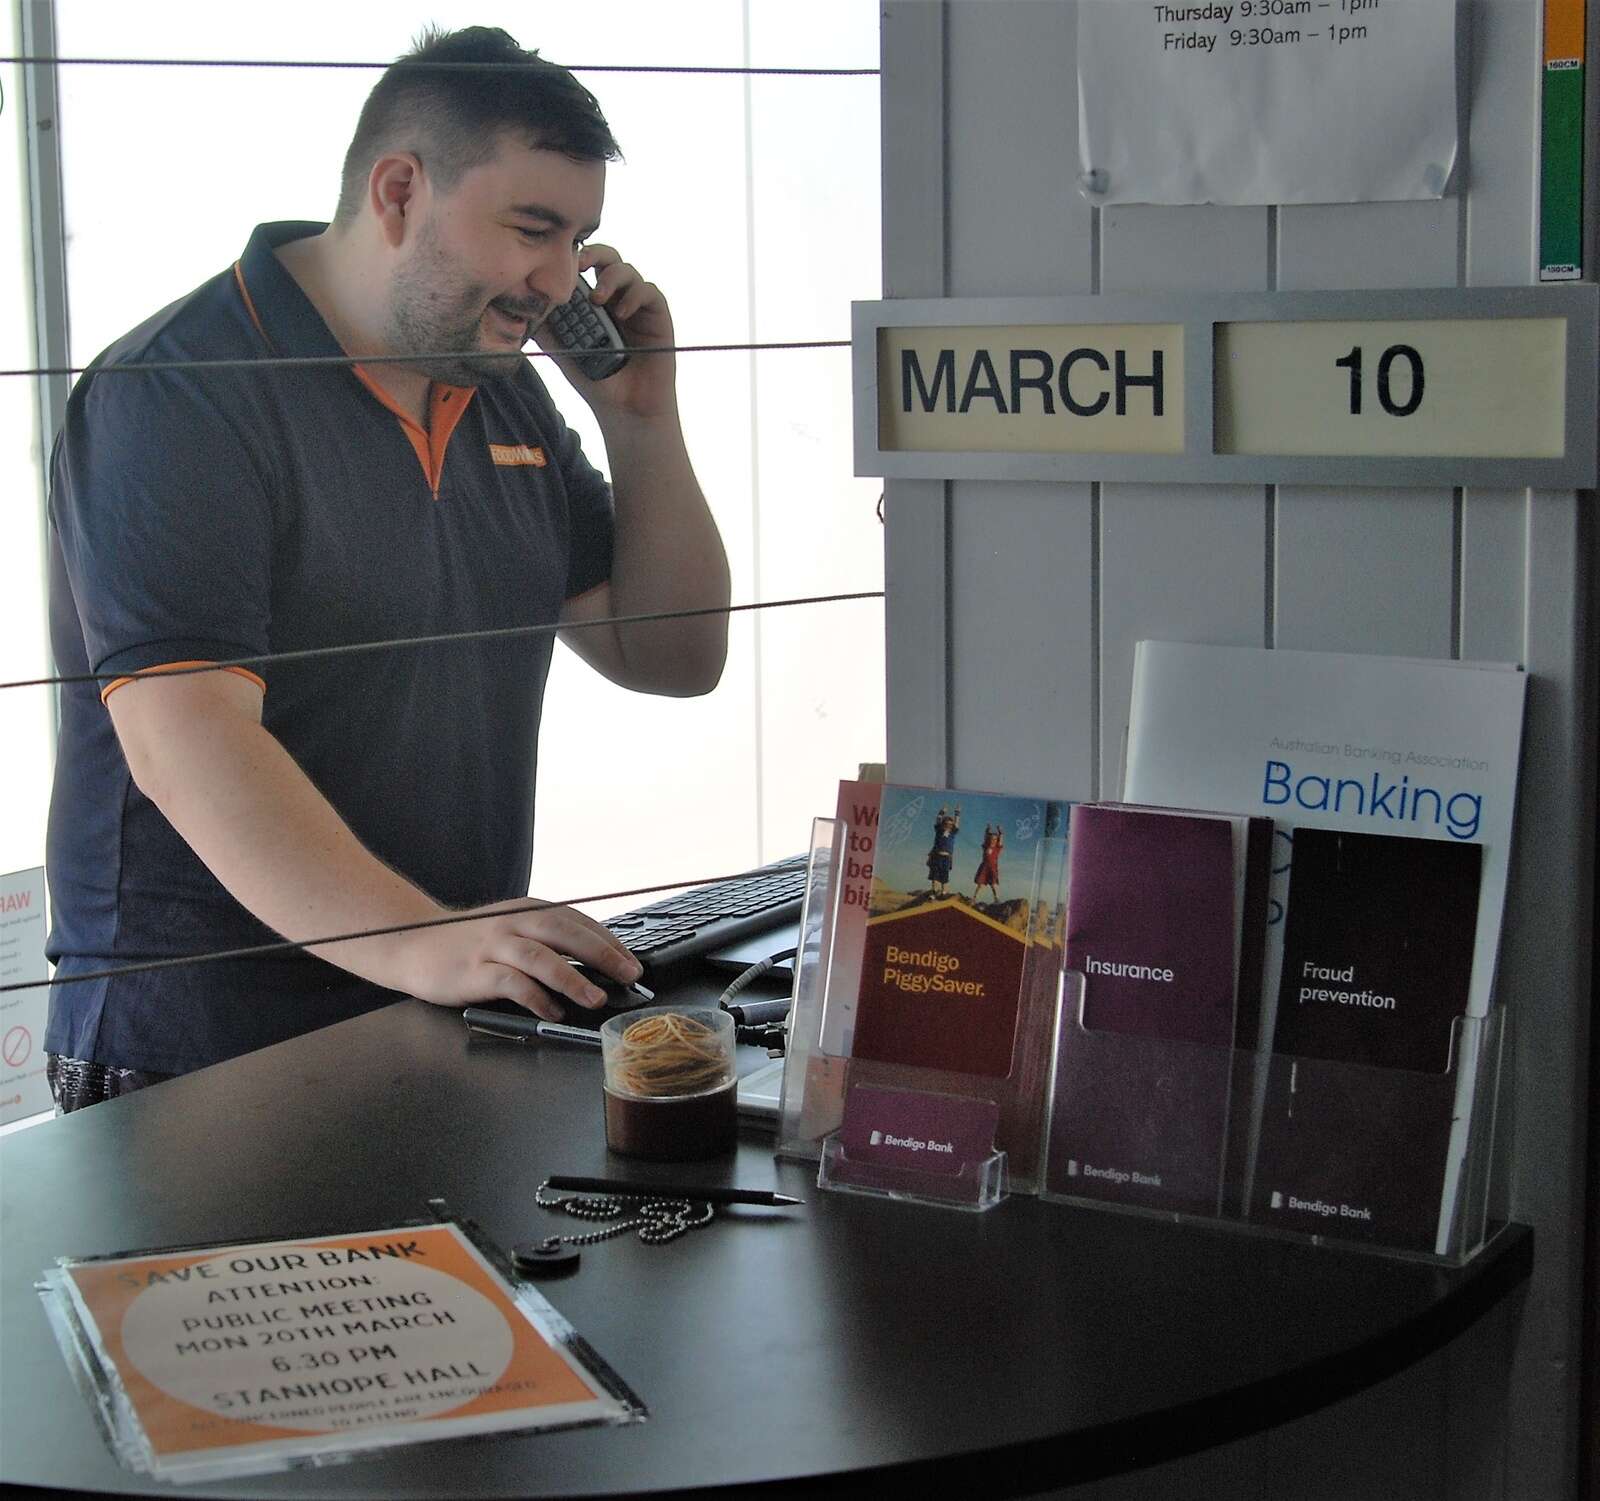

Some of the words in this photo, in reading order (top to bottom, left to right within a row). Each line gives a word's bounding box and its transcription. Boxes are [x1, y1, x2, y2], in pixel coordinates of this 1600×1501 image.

[1153, 5, 1234, 24] Thursday
[1240, 0, 1311, 18] 9:30am
[1163, 31, 1217, 53] Friday
[1229, 27, 1301, 46] 9:30am
[1327, 24, 1368, 45] 1pm
[900, 347, 1165, 418] MARCH
[1335, 343, 1426, 418] 10
[1270, 736, 1340, 755] Australian
[1344, 743, 1401, 765] Banking
[1406, 750, 1489, 773] Association
[1262, 760, 1483, 840] Banking
[852, 804, 880, 827] W
[849, 832, 873, 853] to
[886, 945, 960, 973] Bendigo
[1085, 955, 1175, 984] Insurance
[1302, 962, 1355, 984] Fraud
[883, 968, 986, 997] PiggySaver.
[1299, 985, 1397, 1011] prevention
[884, 1134, 926, 1151] Bendigo
[927, 1140, 954, 1154] Bank
[1083, 1164, 1130, 1184] Bendigo
[1131, 1171, 1162, 1186] Bank
[1288, 1196, 1338, 1216] Bendigo
[1340, 1204, 1372, 1220] Bank
[114, 1262, 221, 1290] SAVE
[229, 1252, 315, 1275] OUR
[317, 1241, 428, 1267] BANK
[207, 1274, 379, 1304] ATTENTION:
[181, 1308, 292, 1333] PUBLIC
[299, 1291, 433, 1320] MEETING
[174, 1334, 250, 1356] MON
[257, 1324, 336, 1347] 20TH
[342, 1311, 457, 1336] MARCH
[347, 1343, 398, 1364] PM
[213, 1371, 398, 1410] STANHOPE
[403, 1360, 492, 1386] HALL
